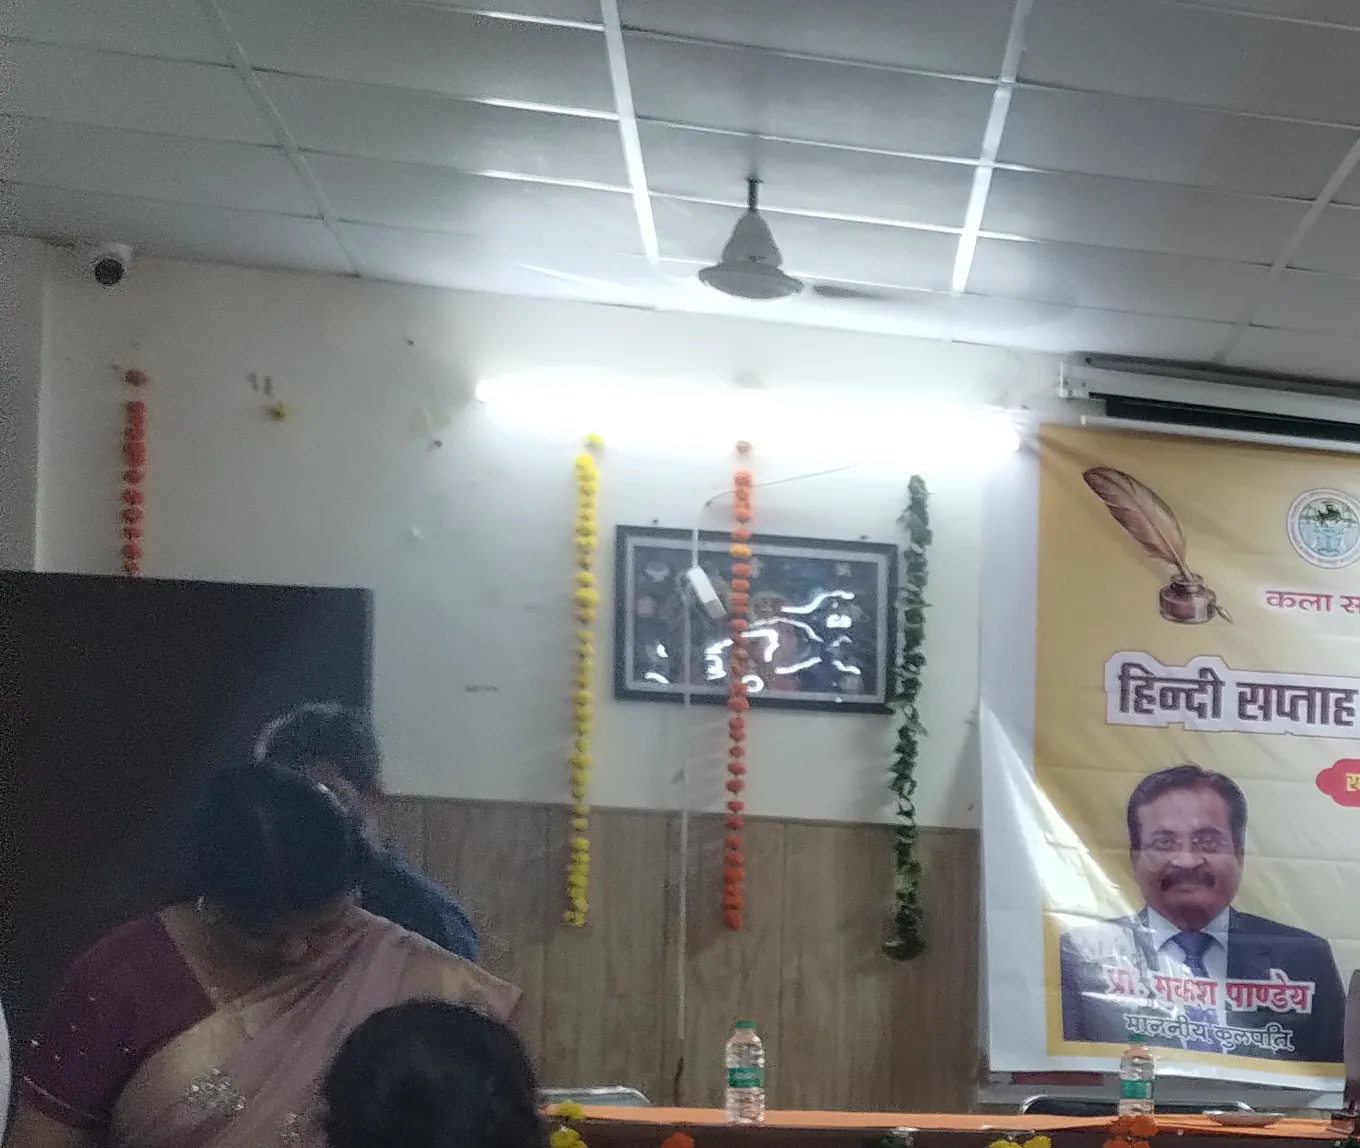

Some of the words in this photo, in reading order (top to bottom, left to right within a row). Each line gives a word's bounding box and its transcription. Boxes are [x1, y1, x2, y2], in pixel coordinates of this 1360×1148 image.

[1266, 590, 1333, 612] कला
[1118, 663, 1226, 720] हिन्दी
[1236, 682, 1360, 727] सप्ताह
[1225, 972, 1310, 1009] पाण्डेय
[1124, 1014, 1214, 1043] माननीय
[1213, 1022, 1295, 1051] कुलपति
